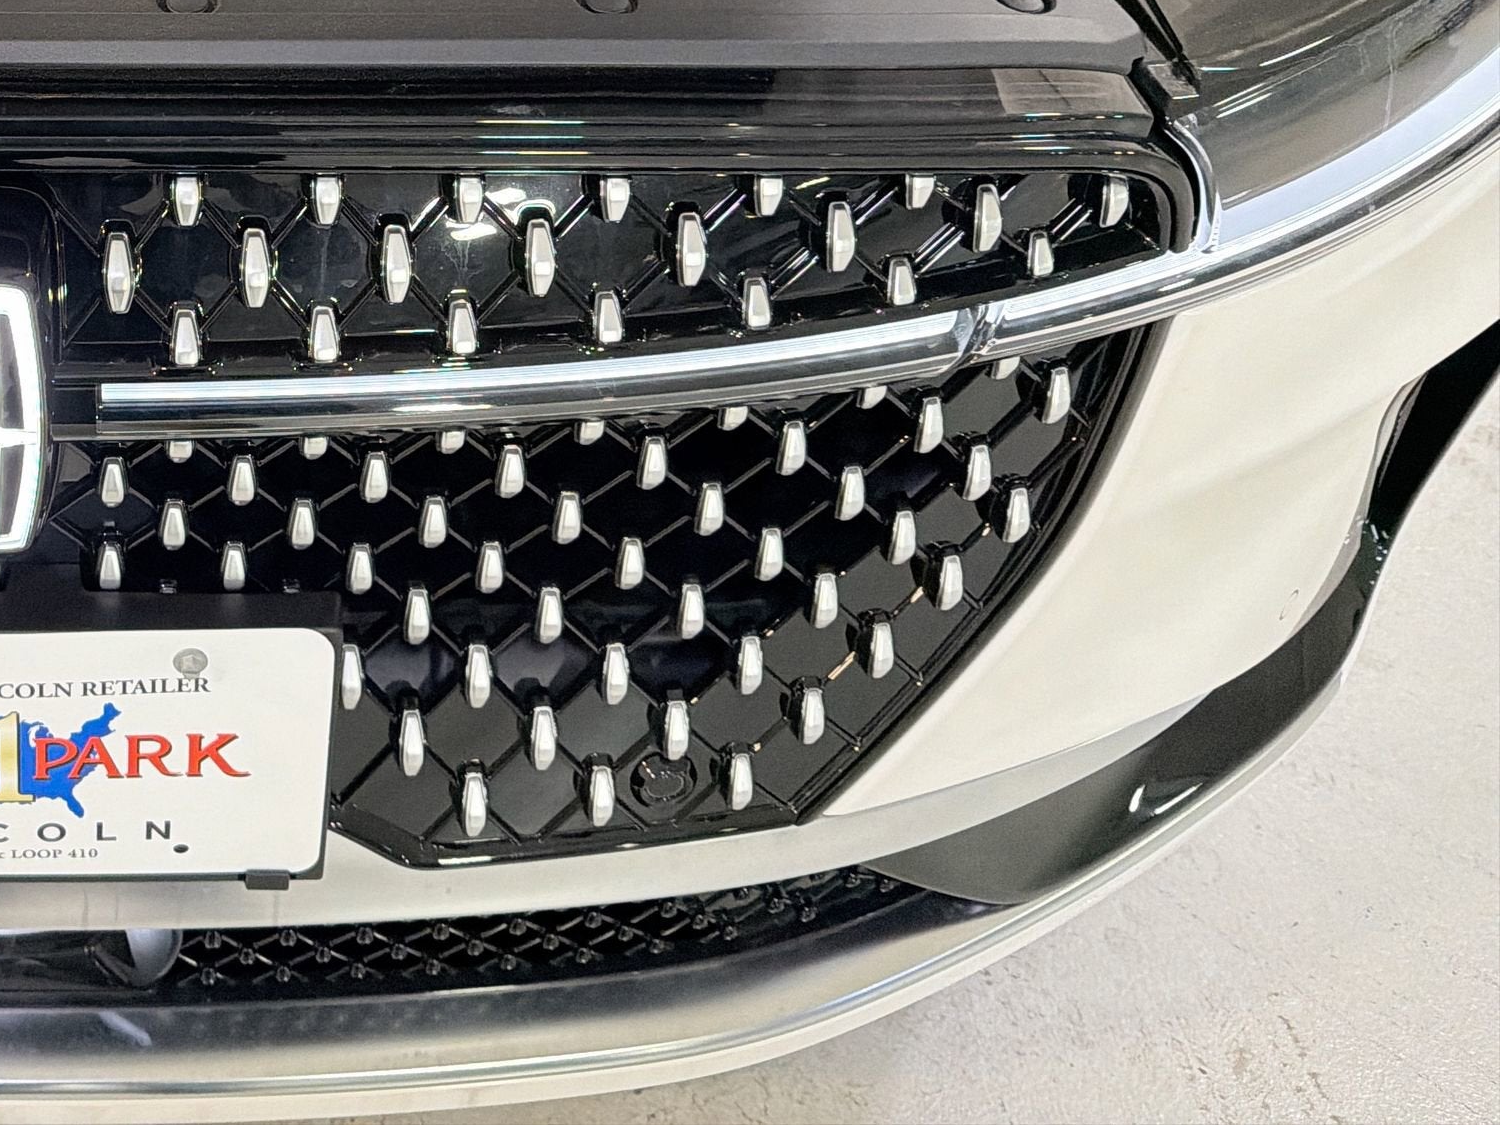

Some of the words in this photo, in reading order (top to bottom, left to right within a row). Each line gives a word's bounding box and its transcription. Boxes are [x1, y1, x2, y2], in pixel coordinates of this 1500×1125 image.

[80, 677, 211, 697] RETAILER
[32, 733, 251, 779] PARK
[11, 849, 62, 859] LOOP
[68, 848, 98, 859] 410
